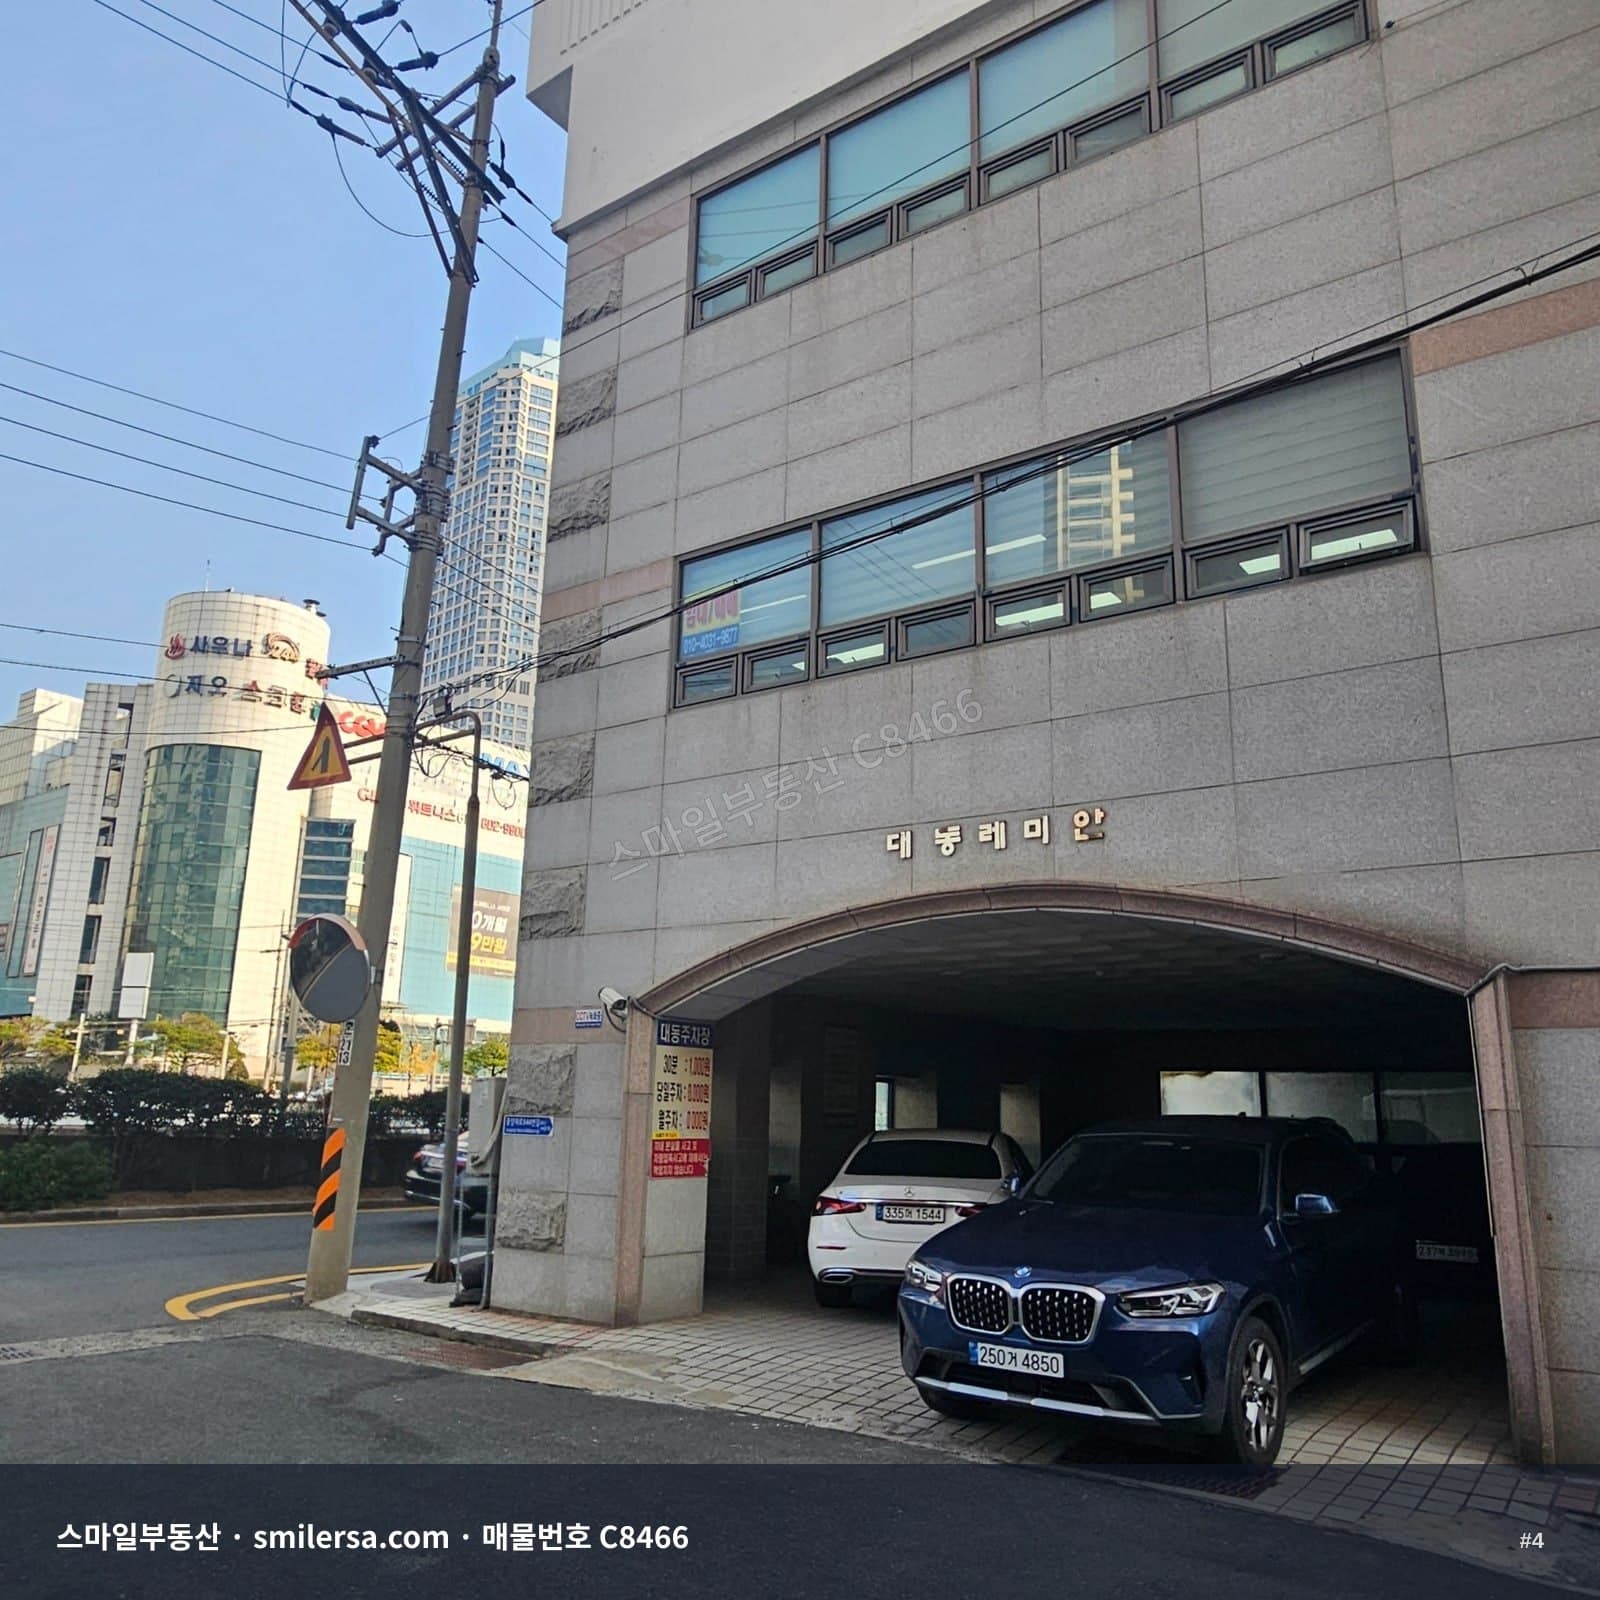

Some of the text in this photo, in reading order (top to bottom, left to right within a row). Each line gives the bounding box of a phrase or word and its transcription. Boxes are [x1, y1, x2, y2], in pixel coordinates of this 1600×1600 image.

[661, 1023, 710, 1046] 대동주차장
[916, 1208, 941, 1220] 1544
[1022, 1352, 1059, 1374] 4850
